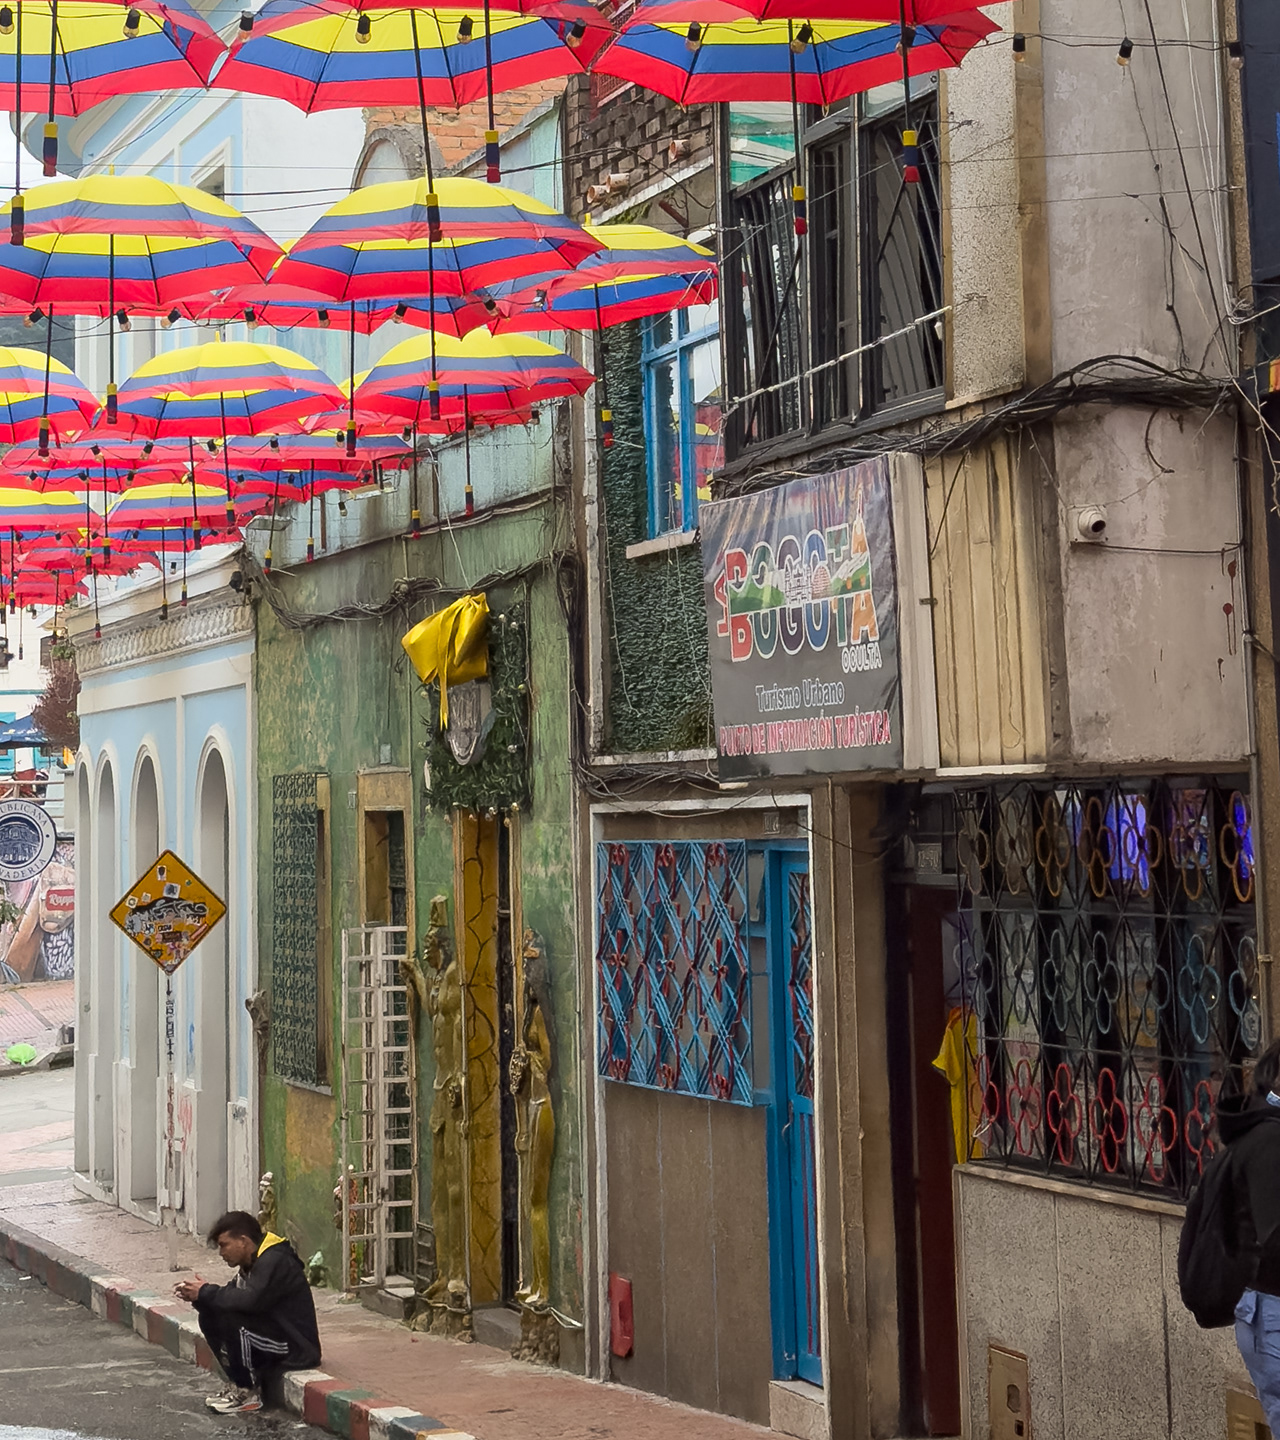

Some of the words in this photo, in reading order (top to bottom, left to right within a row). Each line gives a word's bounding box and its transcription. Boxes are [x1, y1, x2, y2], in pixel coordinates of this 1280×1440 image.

[841, 641, 883, 674] OCULTA
[755, 683, 802, 712] Turismo
[802, 677, 845, 707] Urbano
[720, 724, 752, 756] PUNTO
[751, 723, 767, 755] DE
[766, 708, 835, 754] INFORMACIÓN
[834, 705, 892, 749] TURÍSTICA
